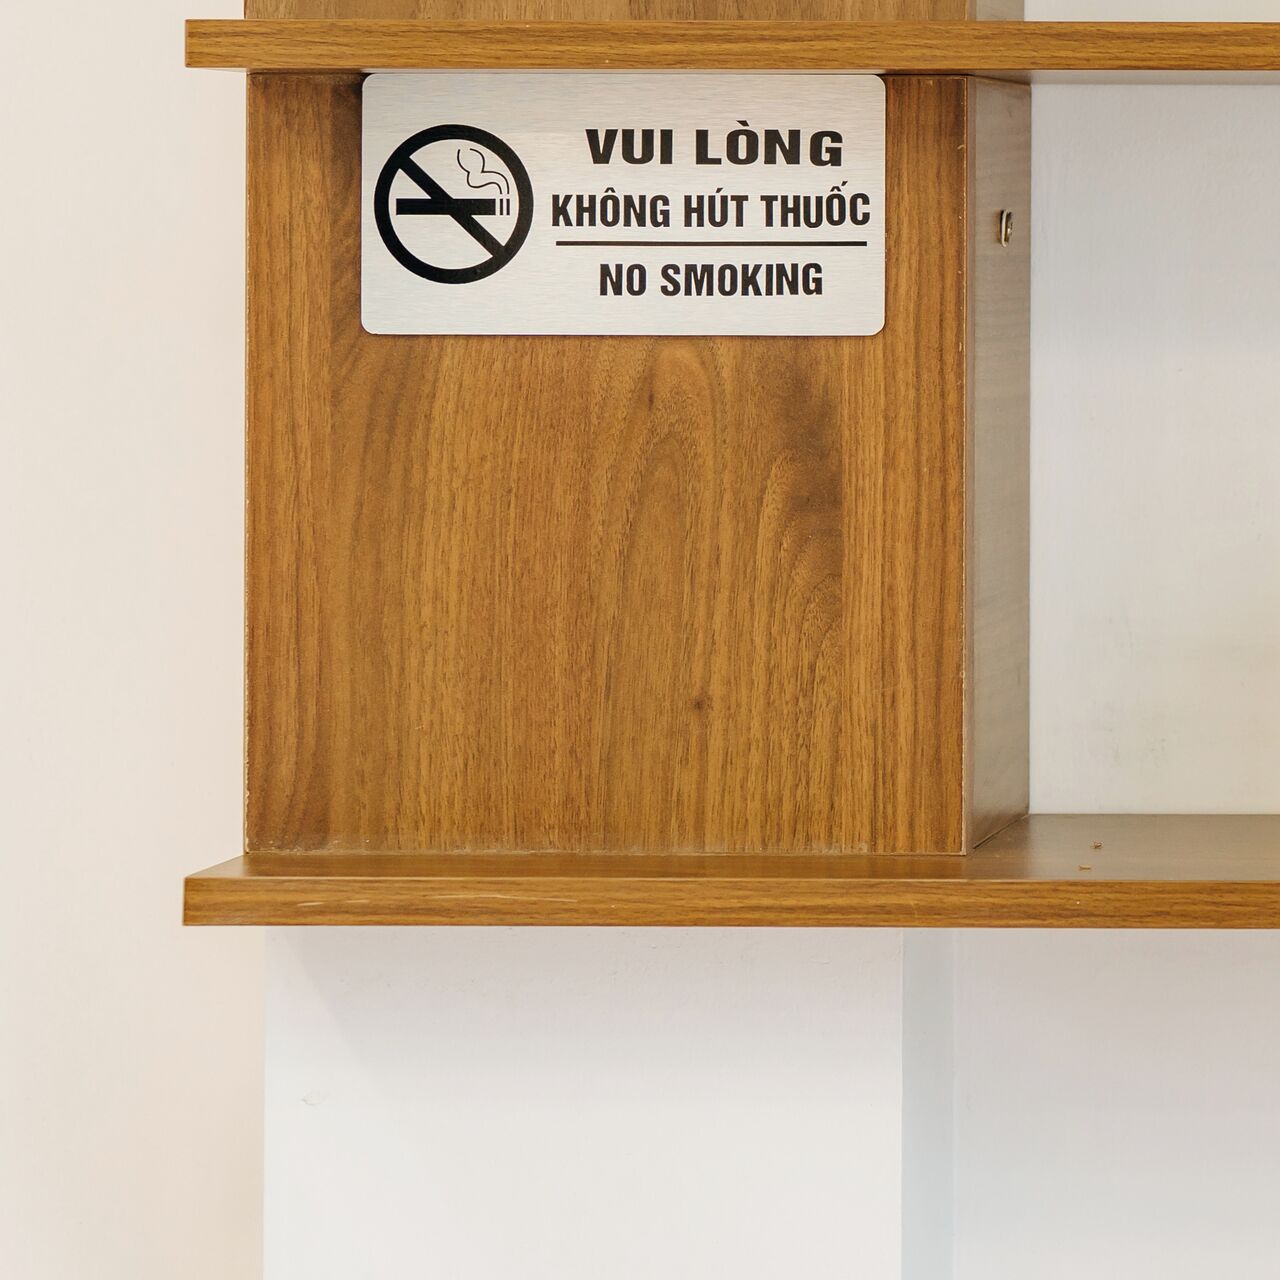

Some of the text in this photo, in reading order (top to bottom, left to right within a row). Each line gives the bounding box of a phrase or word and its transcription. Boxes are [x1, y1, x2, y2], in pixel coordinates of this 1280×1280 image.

[585, 119, 843, 167] VUI LÒNG
[551, 180, 871, 228] KHÔNG HÚT THUỐC
[599, 262, 823, 297] NO SMOKING
